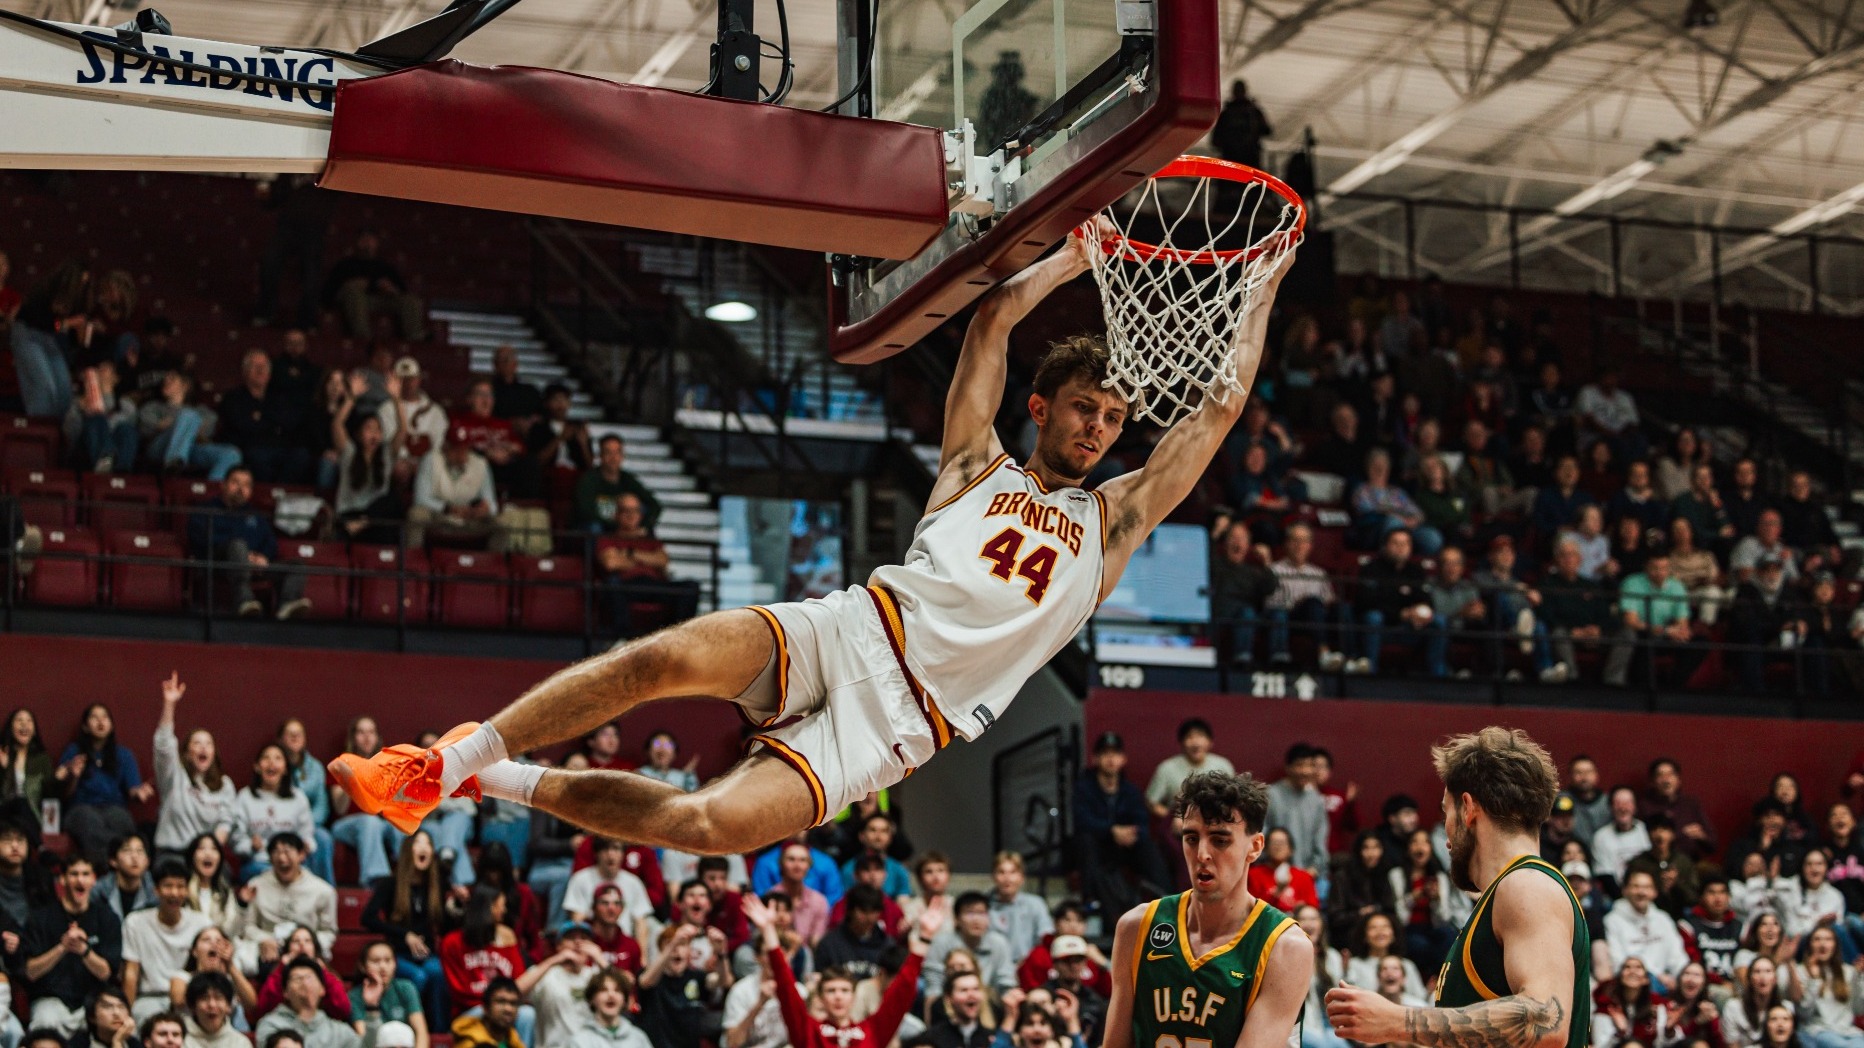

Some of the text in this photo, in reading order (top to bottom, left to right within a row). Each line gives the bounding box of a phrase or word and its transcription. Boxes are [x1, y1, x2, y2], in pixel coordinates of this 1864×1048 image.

[77, 31, 334, 112] SPALDING
[978, 525, 1060, 607] 44
[1099, 664, 1145, 688] 109
[1251, 671, 1287, 698] 211
[1153, 929, 1173, 942] LW
[1152, 985, 1227, 1028] U.S.F
